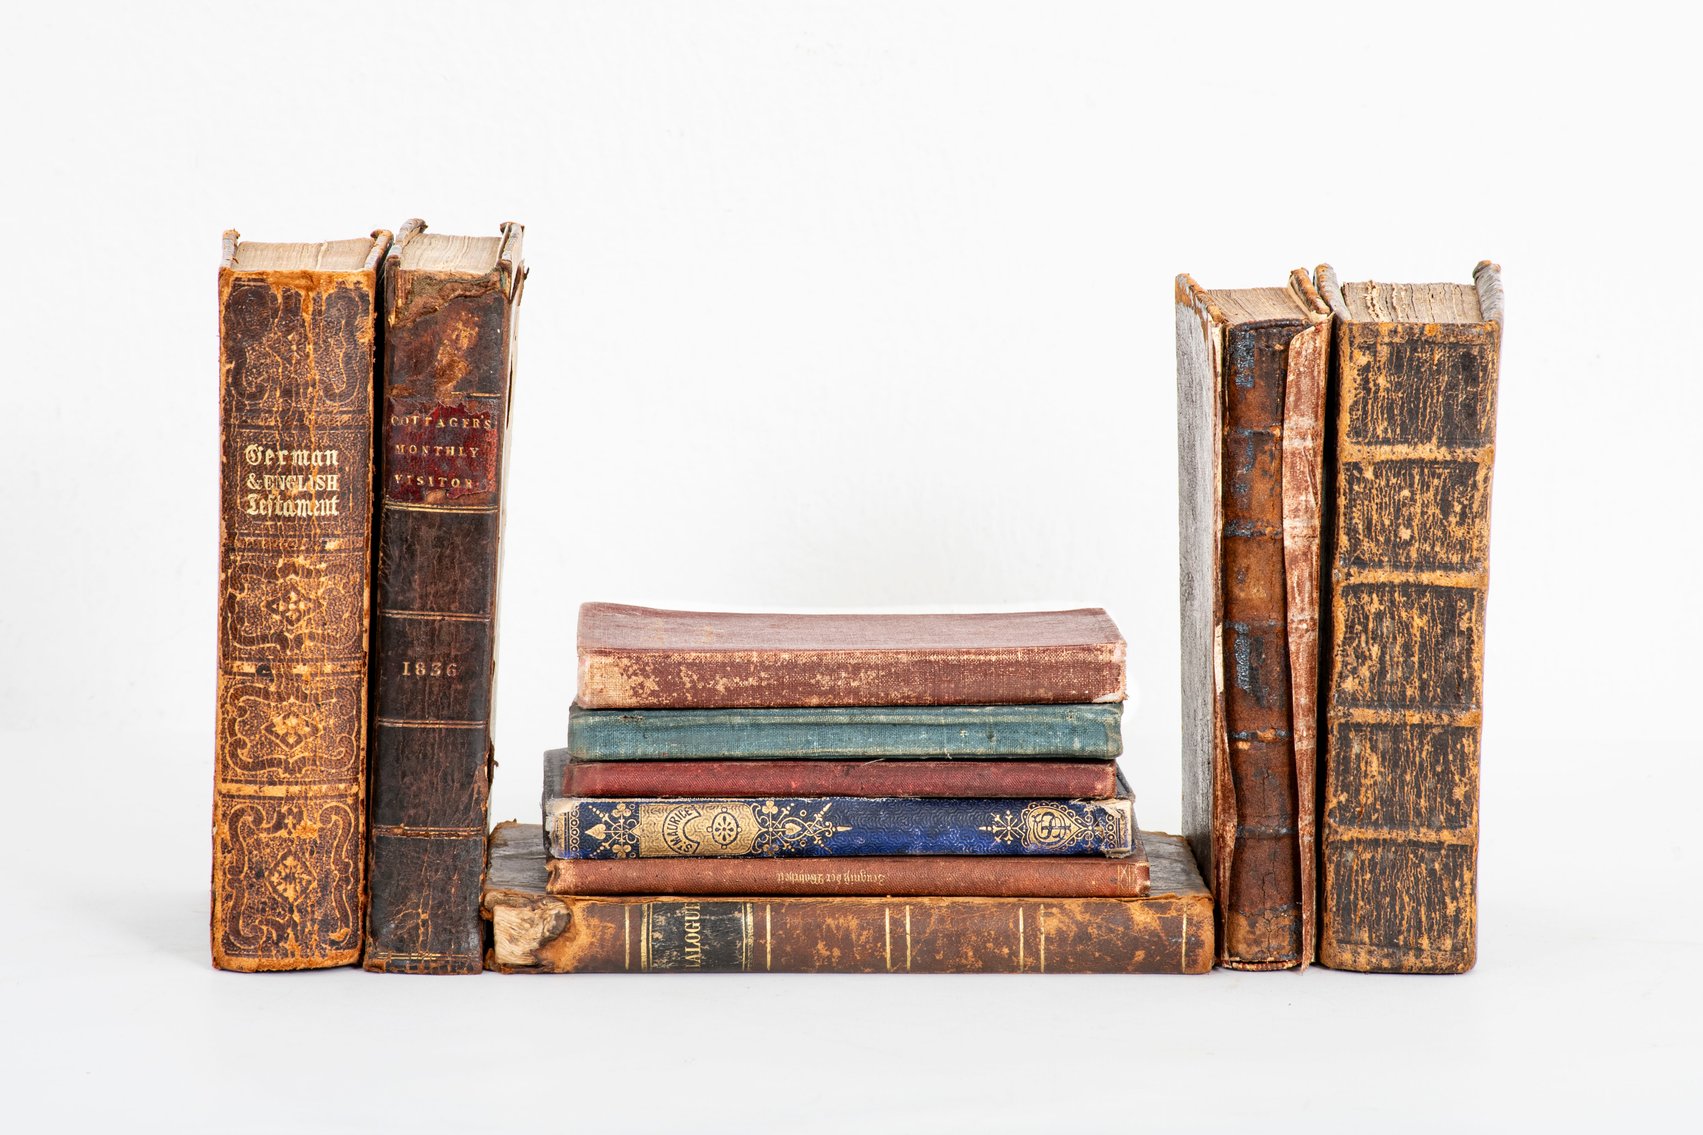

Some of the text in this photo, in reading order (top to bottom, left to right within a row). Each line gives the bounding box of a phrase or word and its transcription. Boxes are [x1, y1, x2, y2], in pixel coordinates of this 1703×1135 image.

[391, 415, 492, 430] COTTAGER'S
[245, 444, 339, 466] German
[395, 444, 479, 457] MONTHLY
[402, 661, 457, 677] 1836
[666, 806, 693, 847] MAURICE
